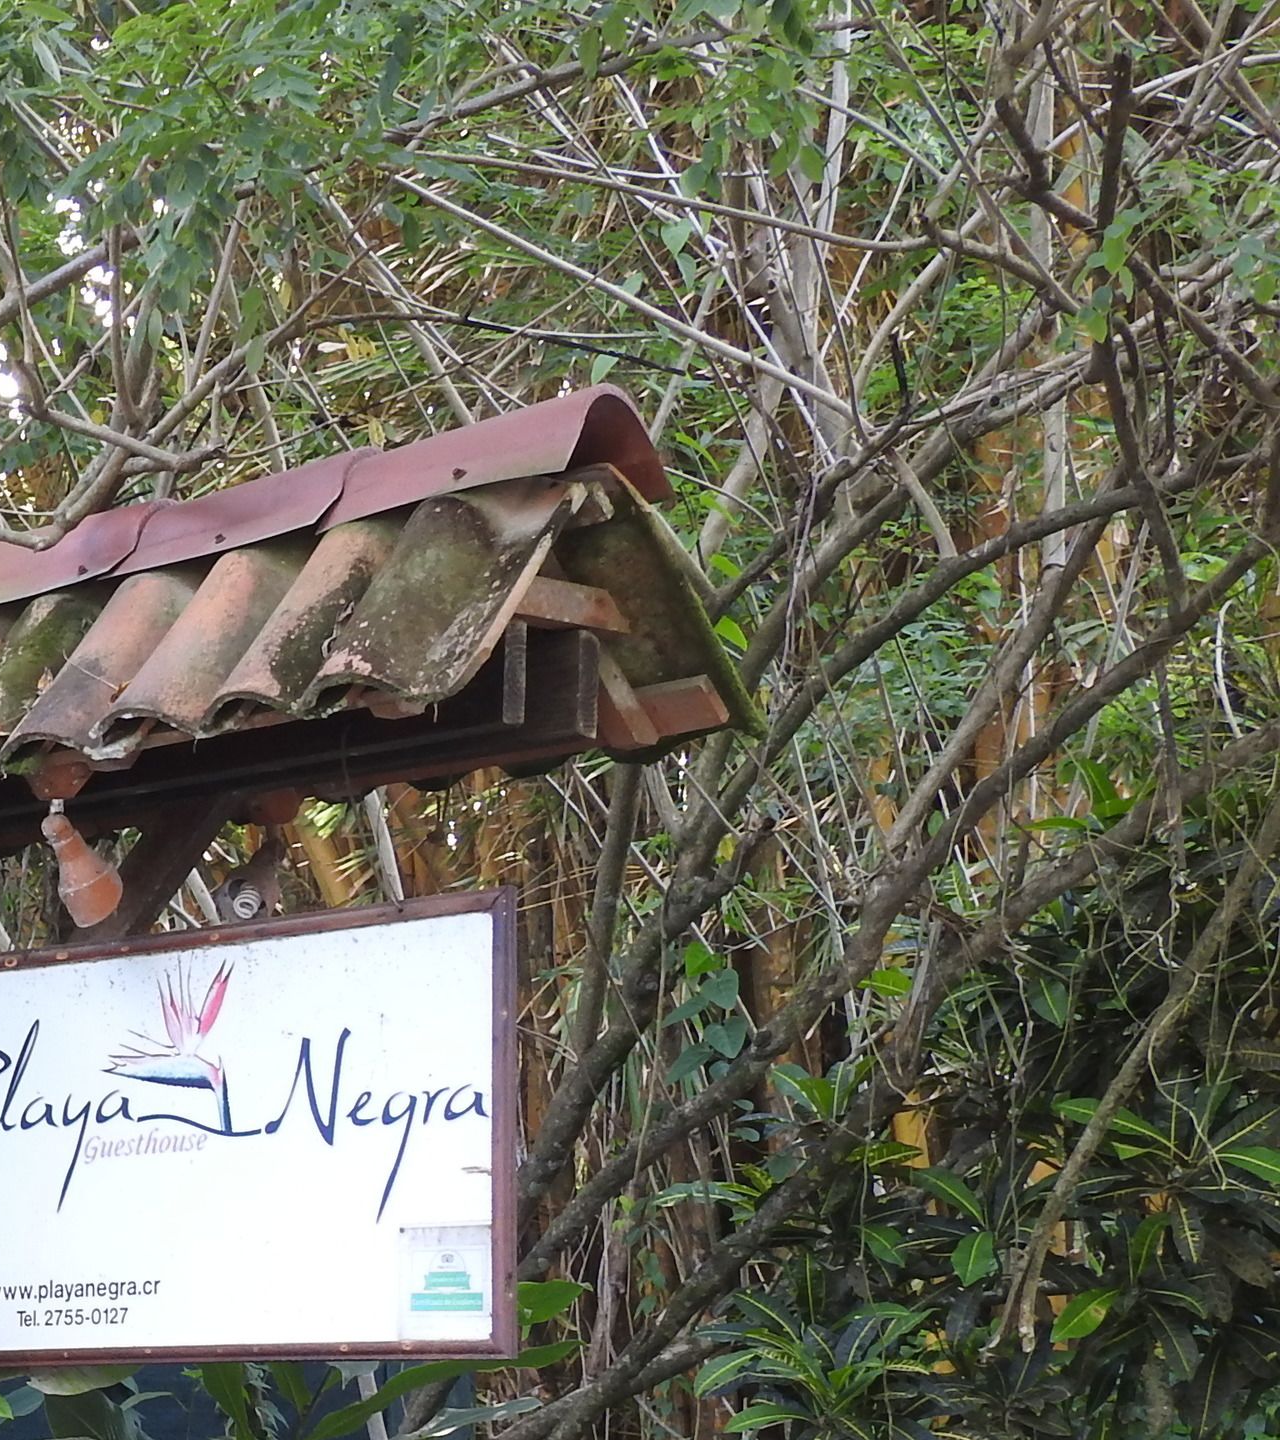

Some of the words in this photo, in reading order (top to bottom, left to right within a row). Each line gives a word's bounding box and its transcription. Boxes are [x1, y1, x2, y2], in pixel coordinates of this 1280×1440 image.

[265, 1028, 489, 1224] Negra
[83, 1127, 208, 1164] Guesthouse
[16, 1310, 41, 1327] Tel.
[44, 1307, 129, 1327] 2755-0127
